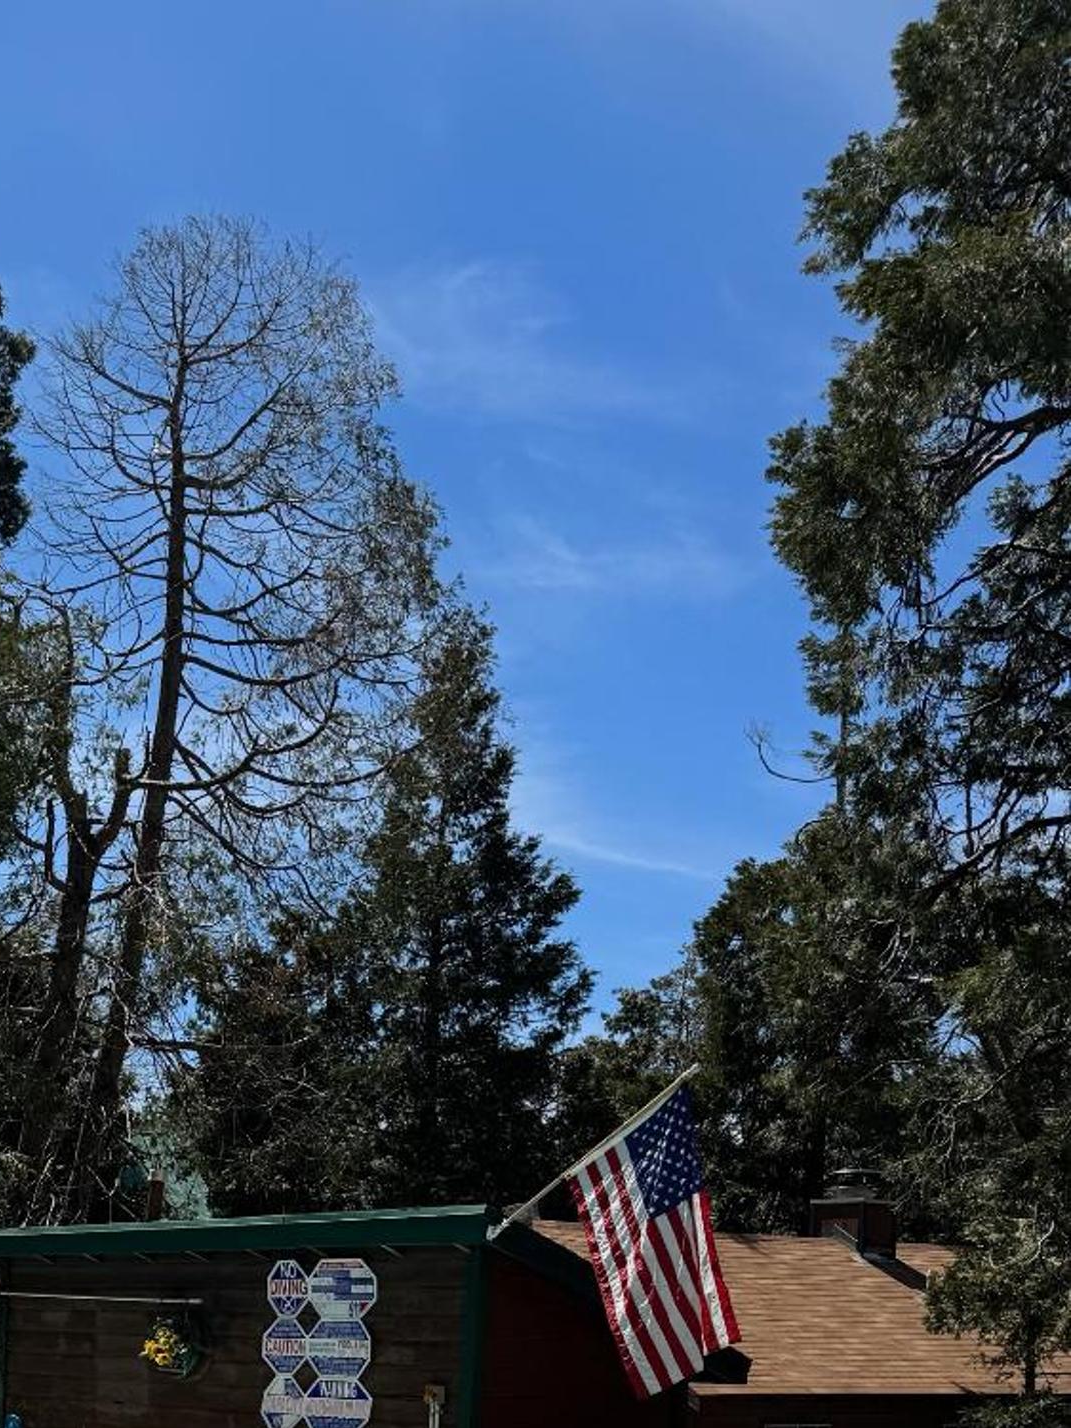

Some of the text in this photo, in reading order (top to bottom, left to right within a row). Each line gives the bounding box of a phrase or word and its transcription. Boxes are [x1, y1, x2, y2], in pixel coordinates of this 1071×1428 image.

[280, 1262, 297, 1278] NO
[270, 1280, 308, 1296] DIVING
[265, 1340, 306, 1355] CAUTION
